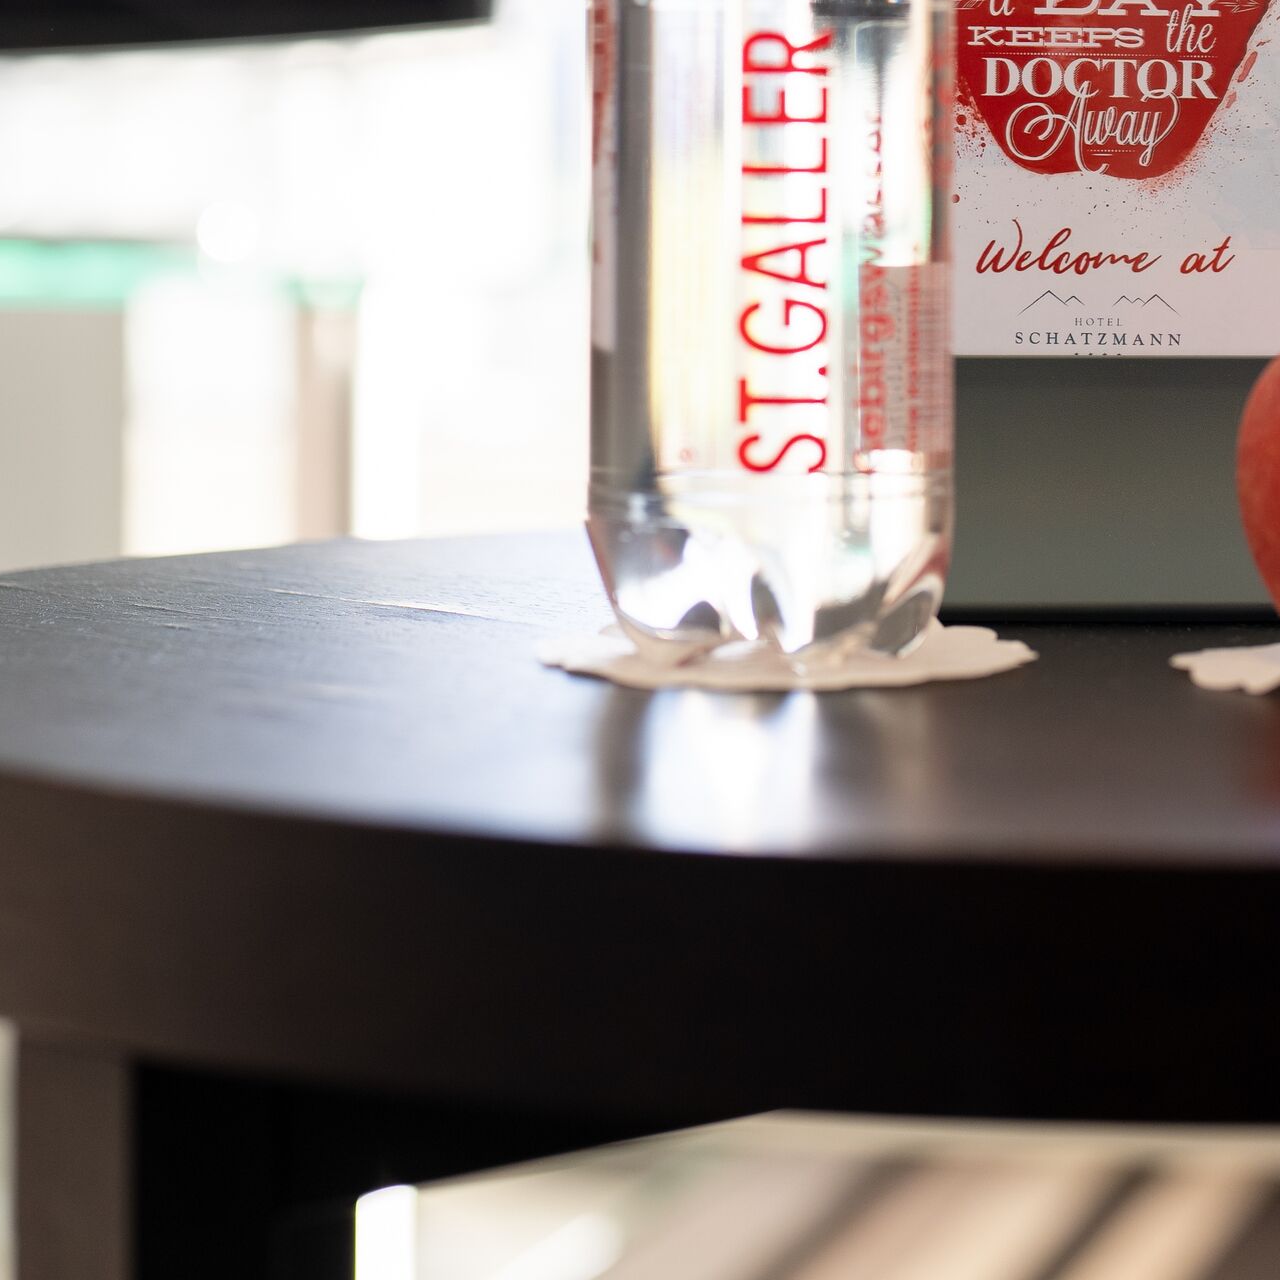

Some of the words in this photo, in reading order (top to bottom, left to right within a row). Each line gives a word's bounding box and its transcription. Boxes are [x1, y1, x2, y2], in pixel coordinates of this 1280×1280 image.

[967, 25, 1145, 48] KEEPS
[1166, 4, 1217, 53] the
[981, 57, 1219, 99] DOCTOR
[1005, 81, 1180, 175] Away
[738, 28, 832, 474] ST.GALLER
[976, 218, 1162, 275] Welcome
[1179, 235, 1236, 275] at
[1014, 331, 1182, 347] SCHATZMANN
[1074, 317, 1124, 327] HOTEL
